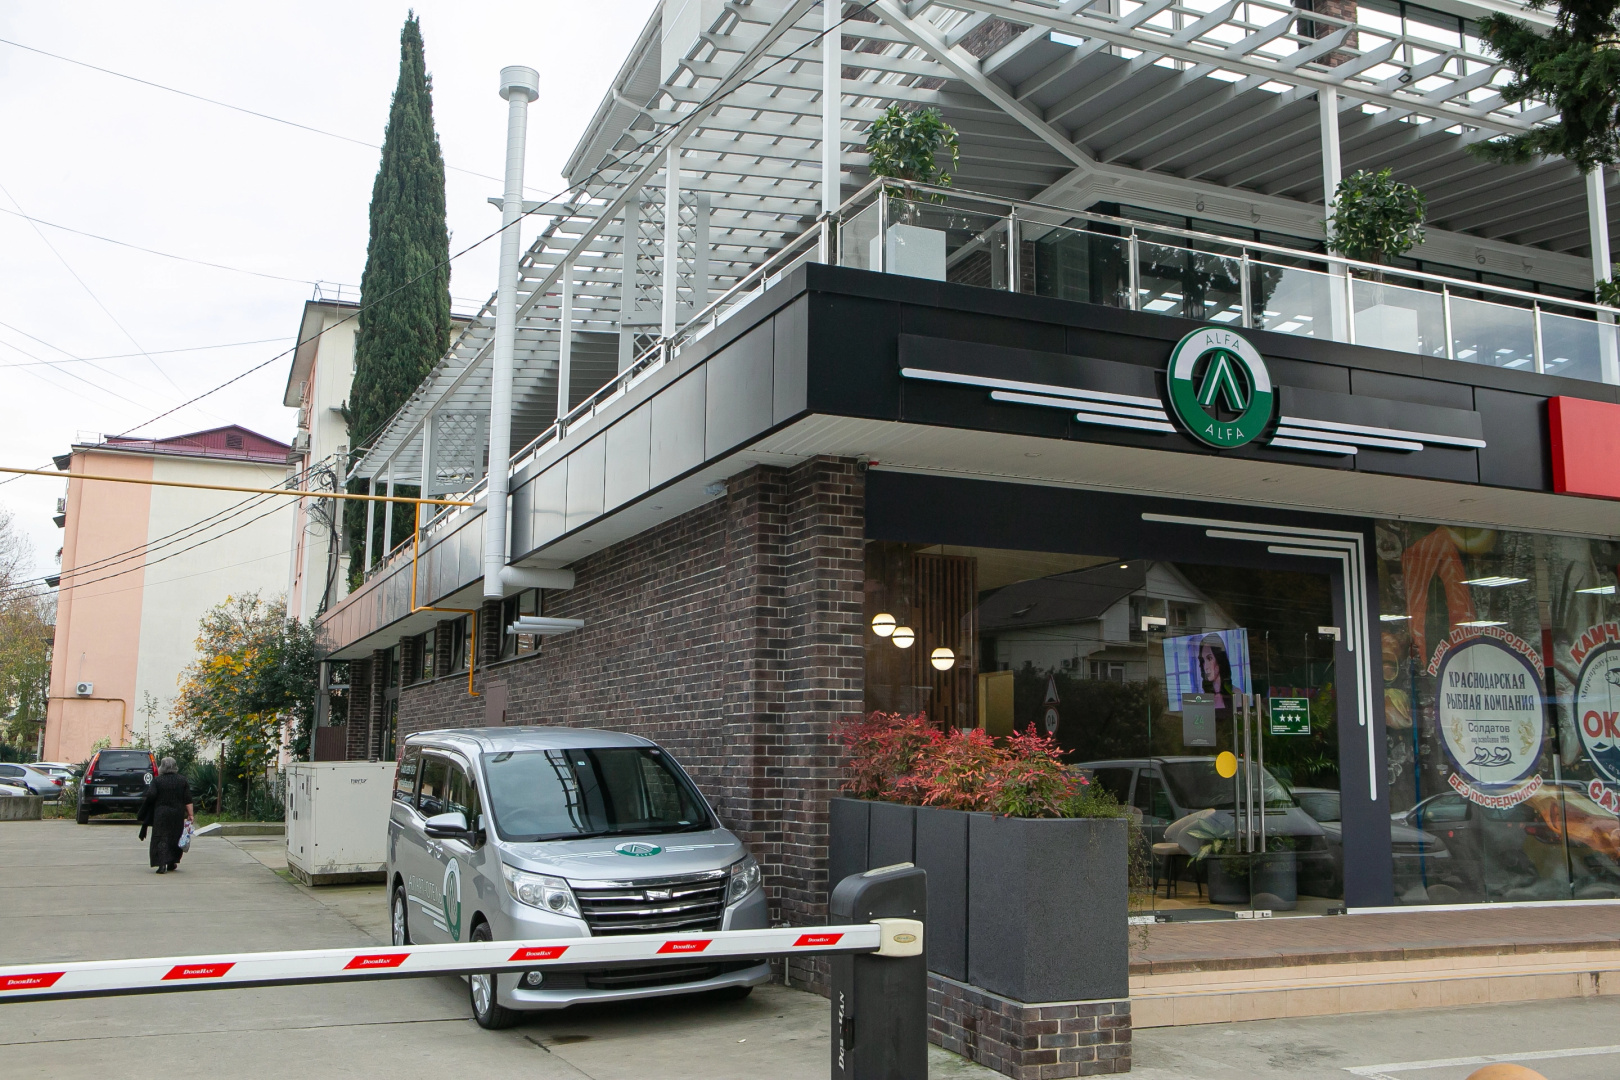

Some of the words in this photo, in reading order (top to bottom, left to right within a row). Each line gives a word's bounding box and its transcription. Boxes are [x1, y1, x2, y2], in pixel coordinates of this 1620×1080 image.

[1206, 332, 1240, 351] ALFA
[1205, 423, 1245, 441] ALFA
[1428, 640, 1450, 676] РЫБА
[1451, 629, 1463, 643] И
[1465, 626, 1544, 678] МОРЕПРОДУКТЫ
[1449, 671, 1526, 690] КРАСНОДАРСКАЯ
[1446, 692, 1482, 711] РЫБНАЯ
[1484, 694, 1535, 711] КОМПАНИЯ
[1468, 722, 1510, 733] Солдатов
[1449, 774, 1470, 796] БЕЗ
[1471, 775, 1543, 807] ПОСРЕДНИКОВ
